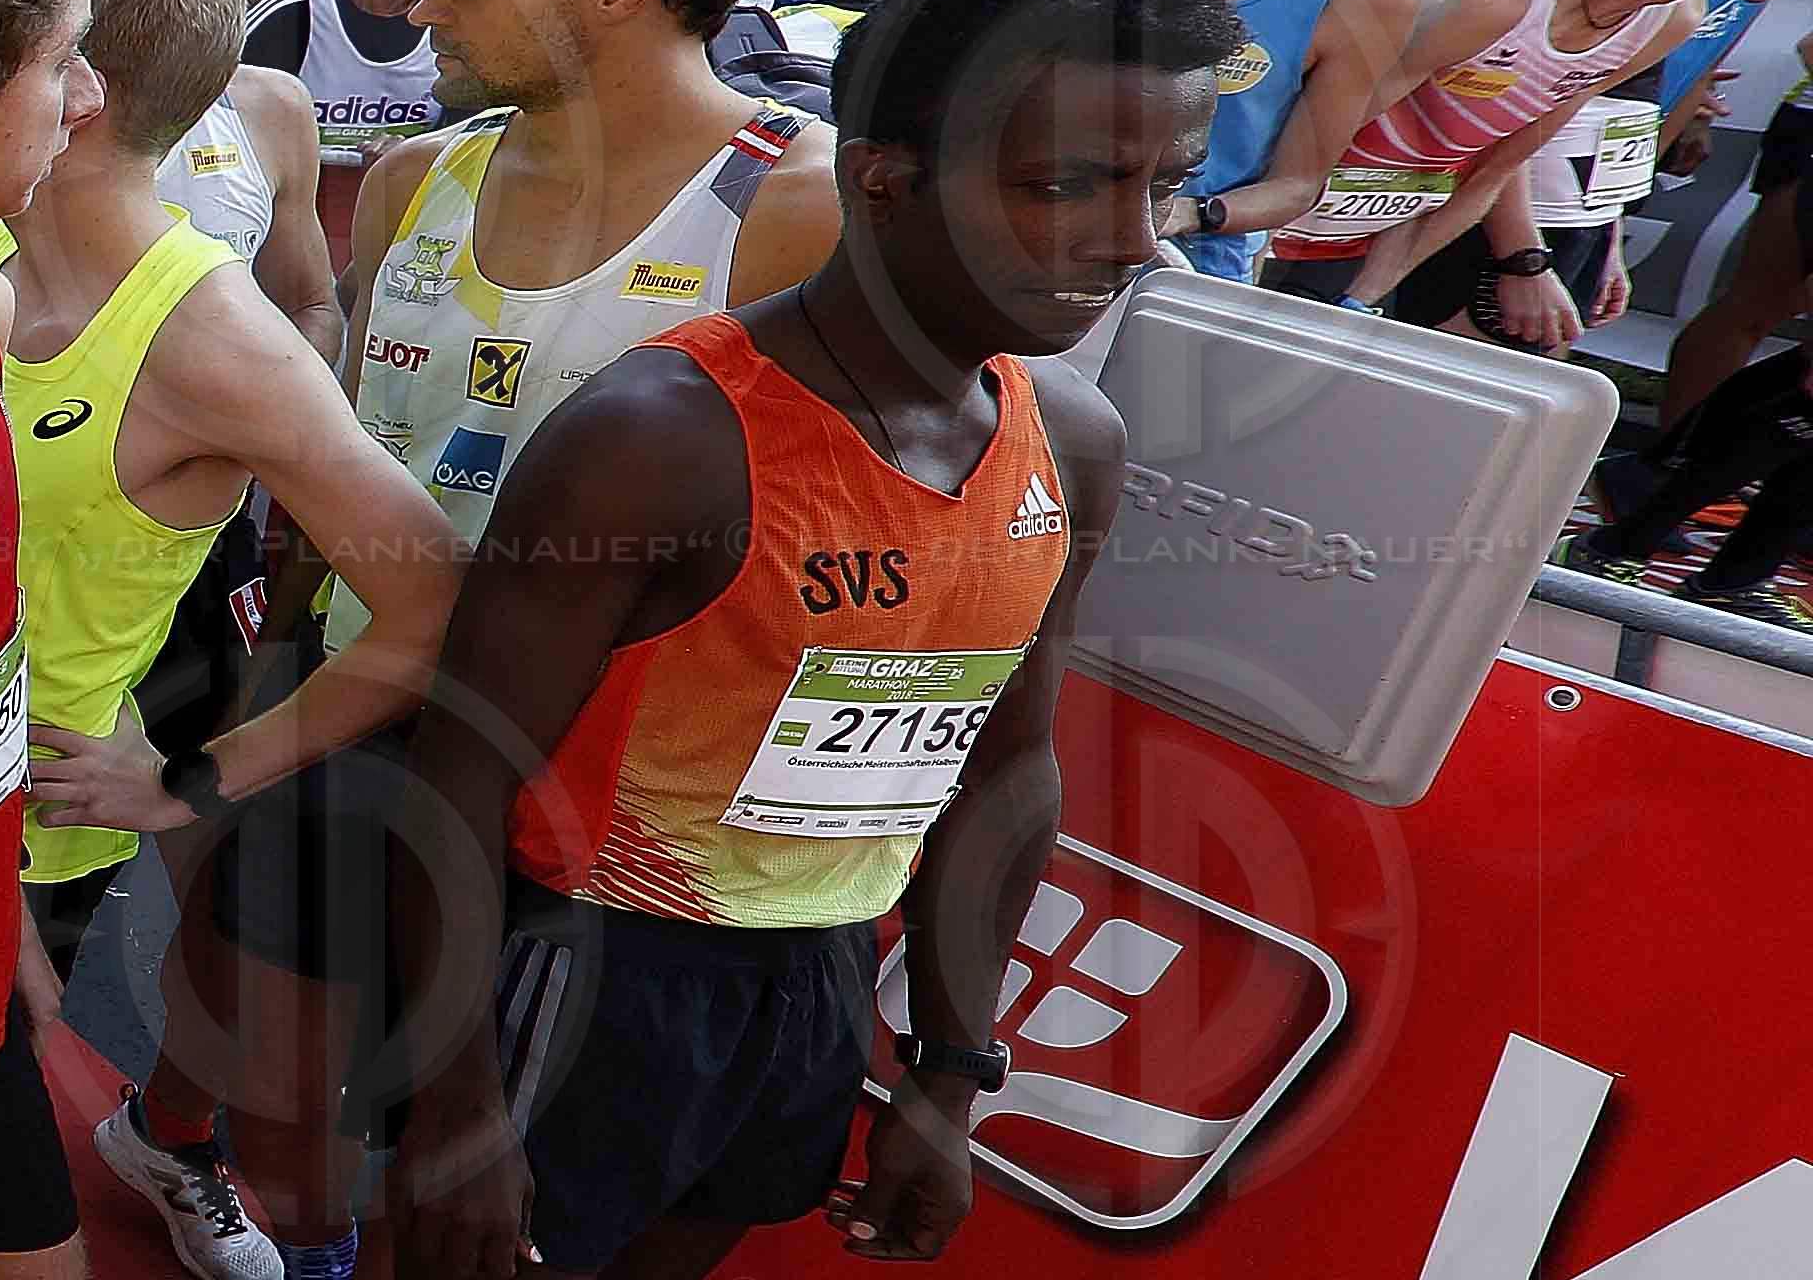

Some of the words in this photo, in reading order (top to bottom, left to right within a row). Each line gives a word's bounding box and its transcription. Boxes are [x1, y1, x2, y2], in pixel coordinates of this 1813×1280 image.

[311, 96, 429, 124] adidas
[1330, 194, 1423, 217] 27089
[632, 263, 703, 294] Murauer
[1007, 513, 1064, 541] adida
[800, 549, 910, 616] SVS
[870, 658, 940, 678] GRAZ
[847, 679, 911, 689] MARATHON
[886, 690, 914, 700] 2018
[815, 705, 991, 754] 27158
[787, 756, 864, 770] Österreichische
[864, 758, 932, 769] Meisterschaften
